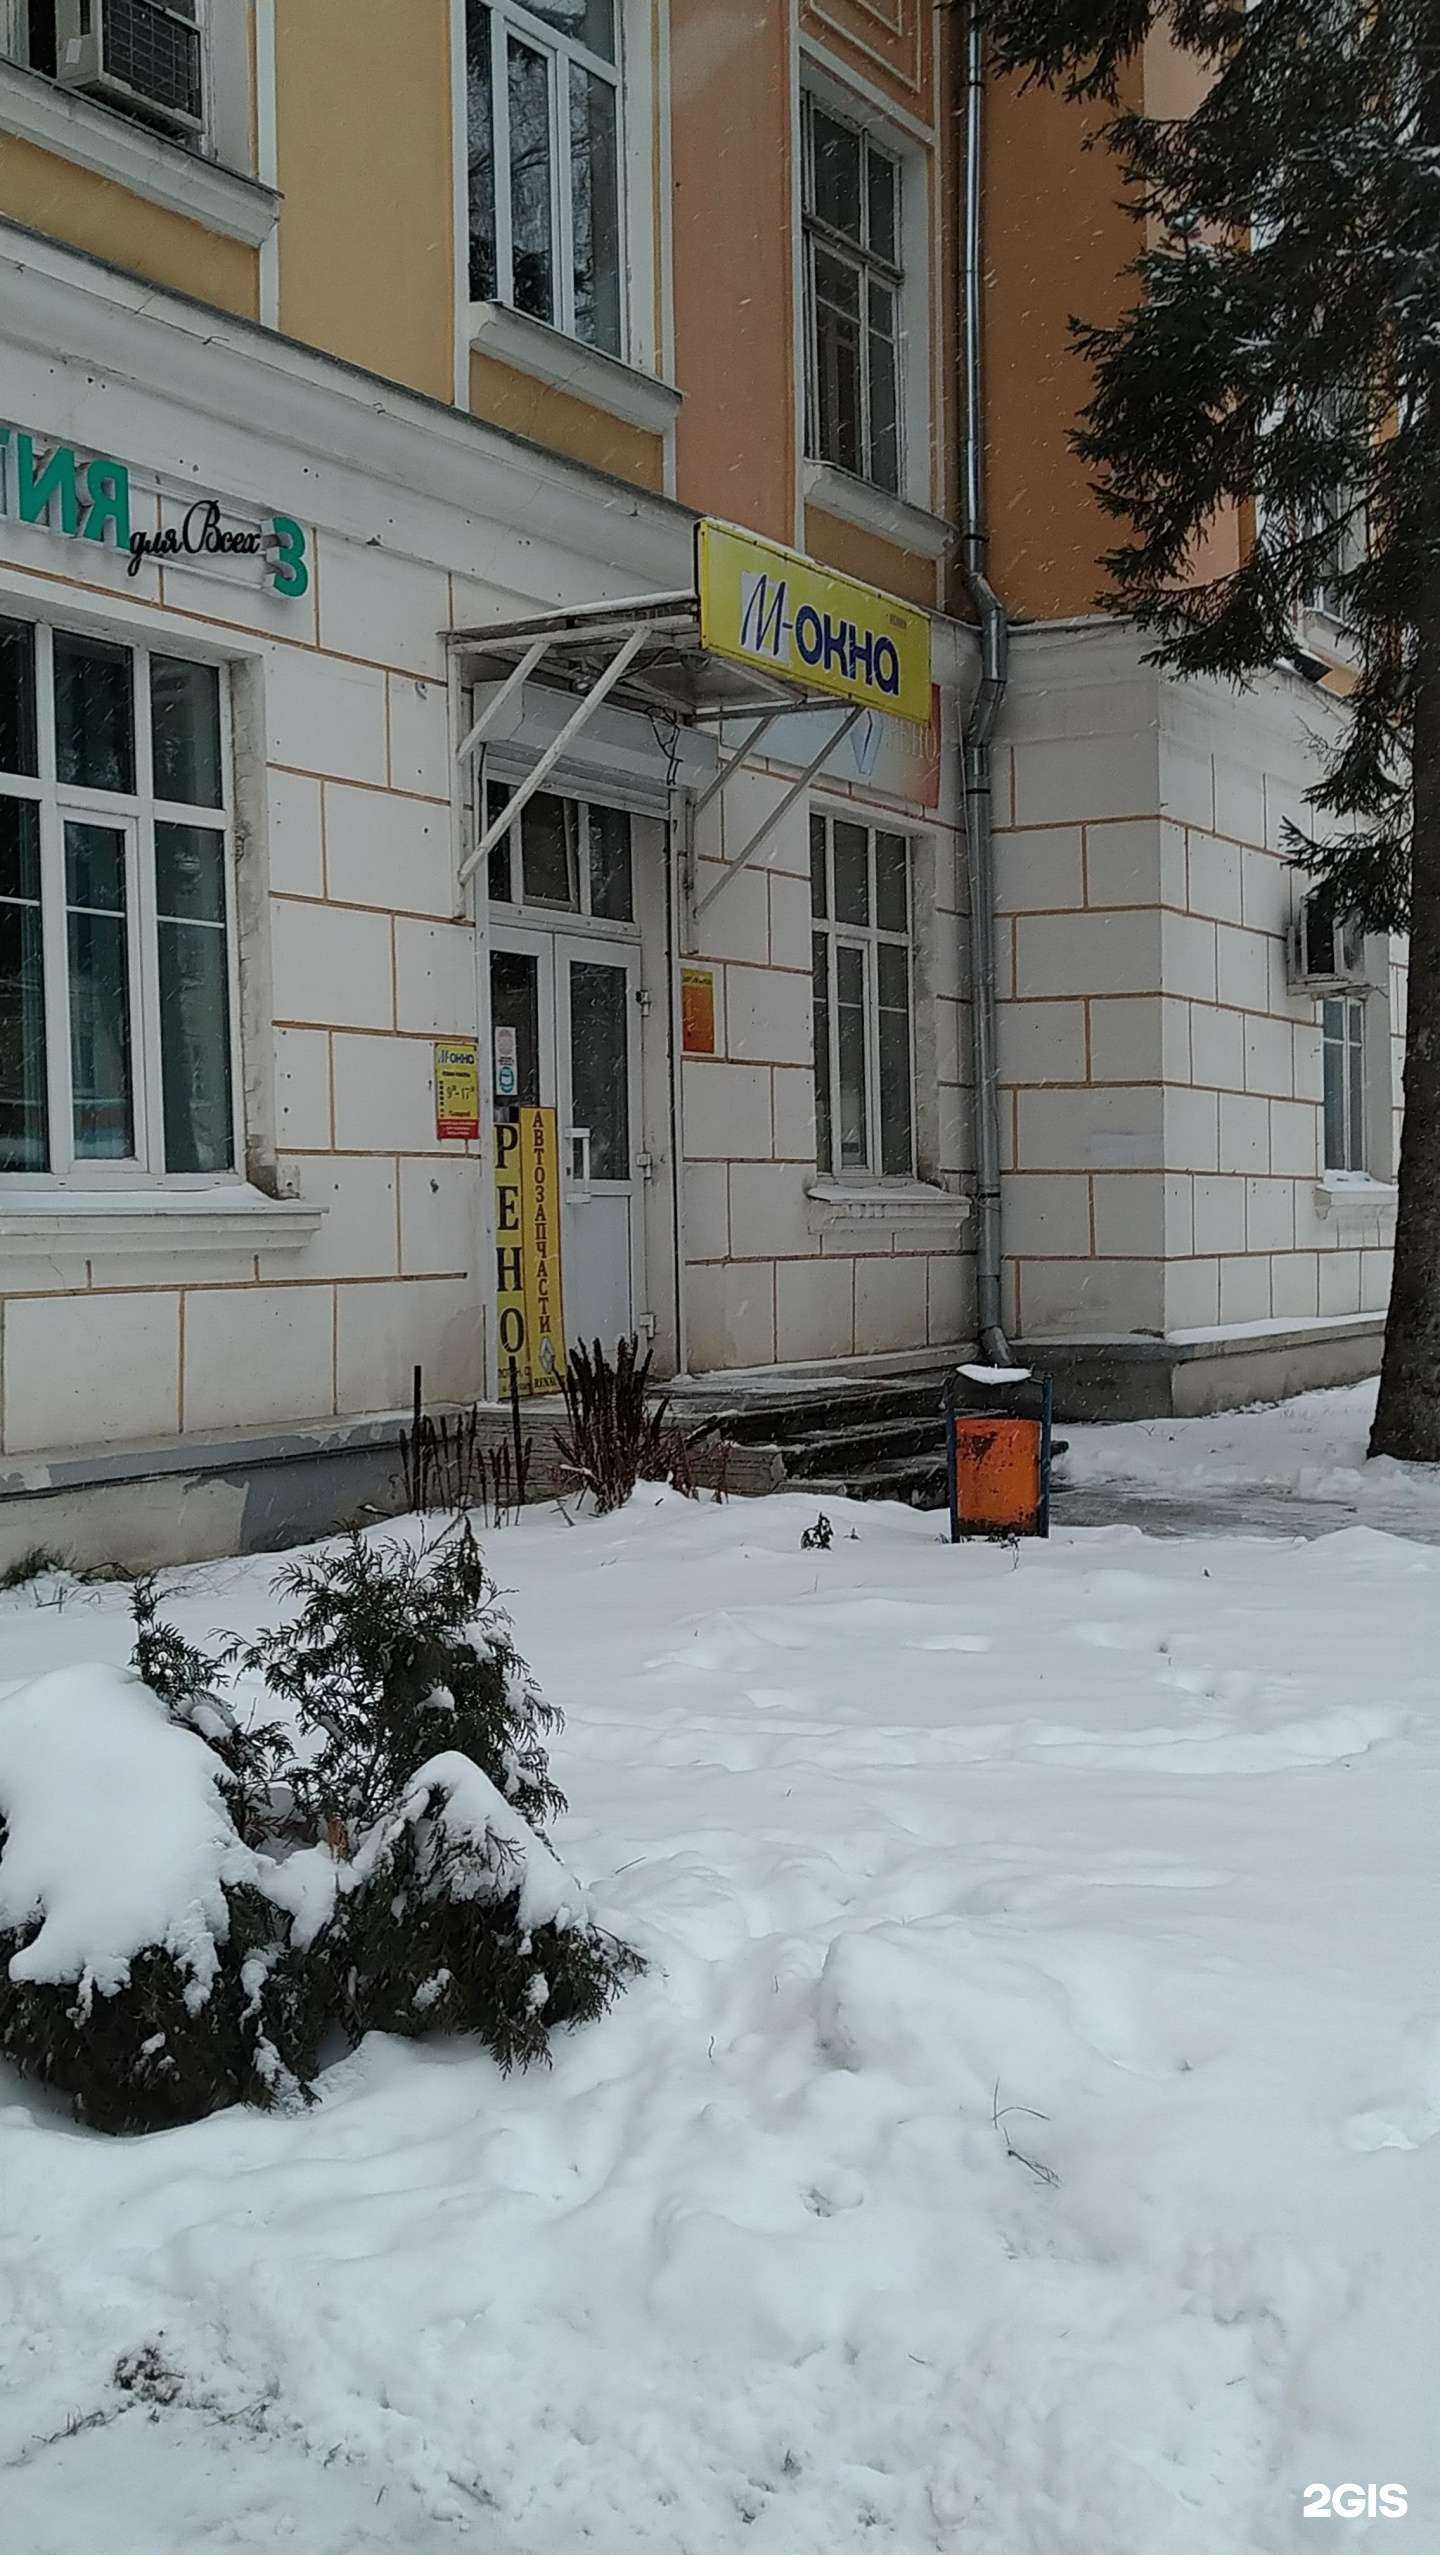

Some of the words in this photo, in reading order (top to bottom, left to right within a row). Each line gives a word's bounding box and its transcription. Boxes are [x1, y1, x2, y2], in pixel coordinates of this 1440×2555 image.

[0, 428, 131, 553] ИЯ
[128, 527, 184, 577] для
[182, 500, 261, 555] Всех
[494, 1122, 525, 1353] РЕНО
[532, 1110, 552, 1334] АВТОЗАПЧАСТИ
